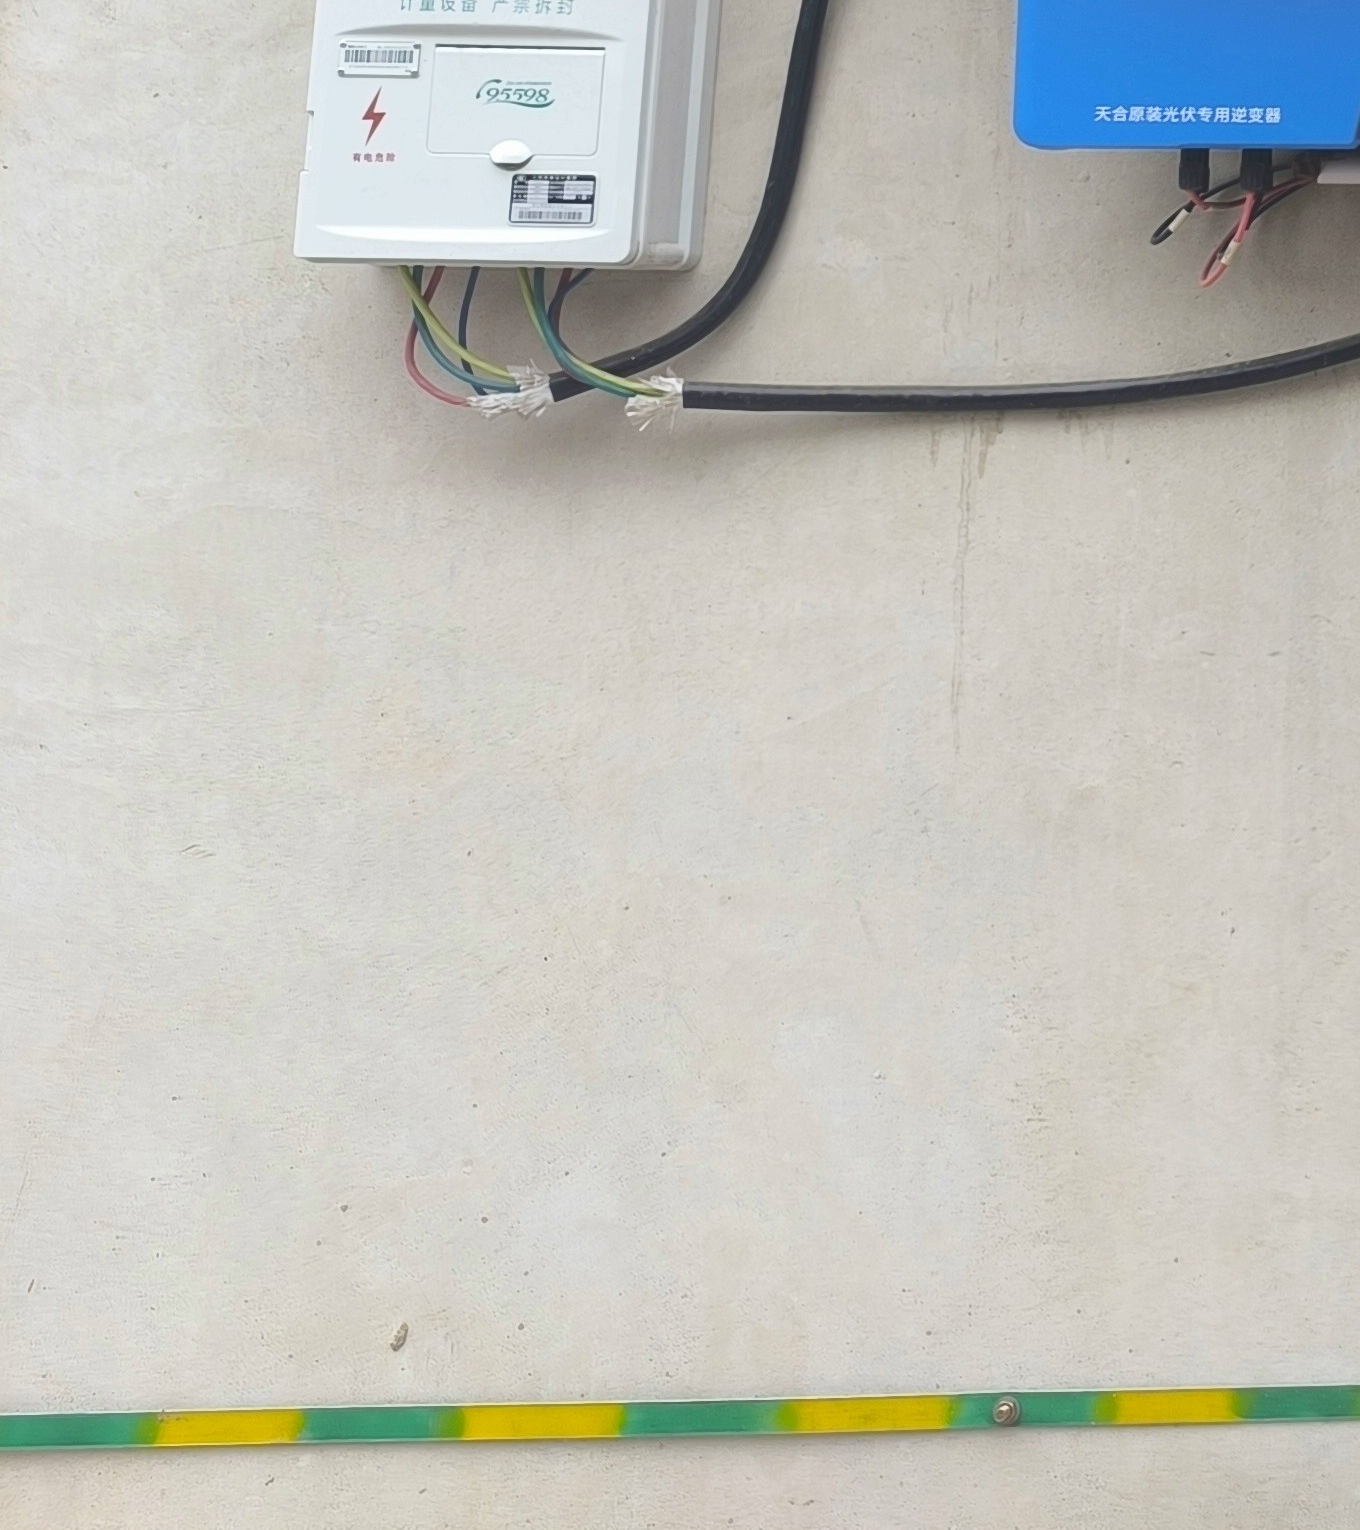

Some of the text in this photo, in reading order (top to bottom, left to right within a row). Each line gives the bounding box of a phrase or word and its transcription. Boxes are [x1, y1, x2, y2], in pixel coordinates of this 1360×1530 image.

[486, 87, 550, 103] 95598
[1094, 106, 1281, 124] 天合原装光伏专用逆变器
